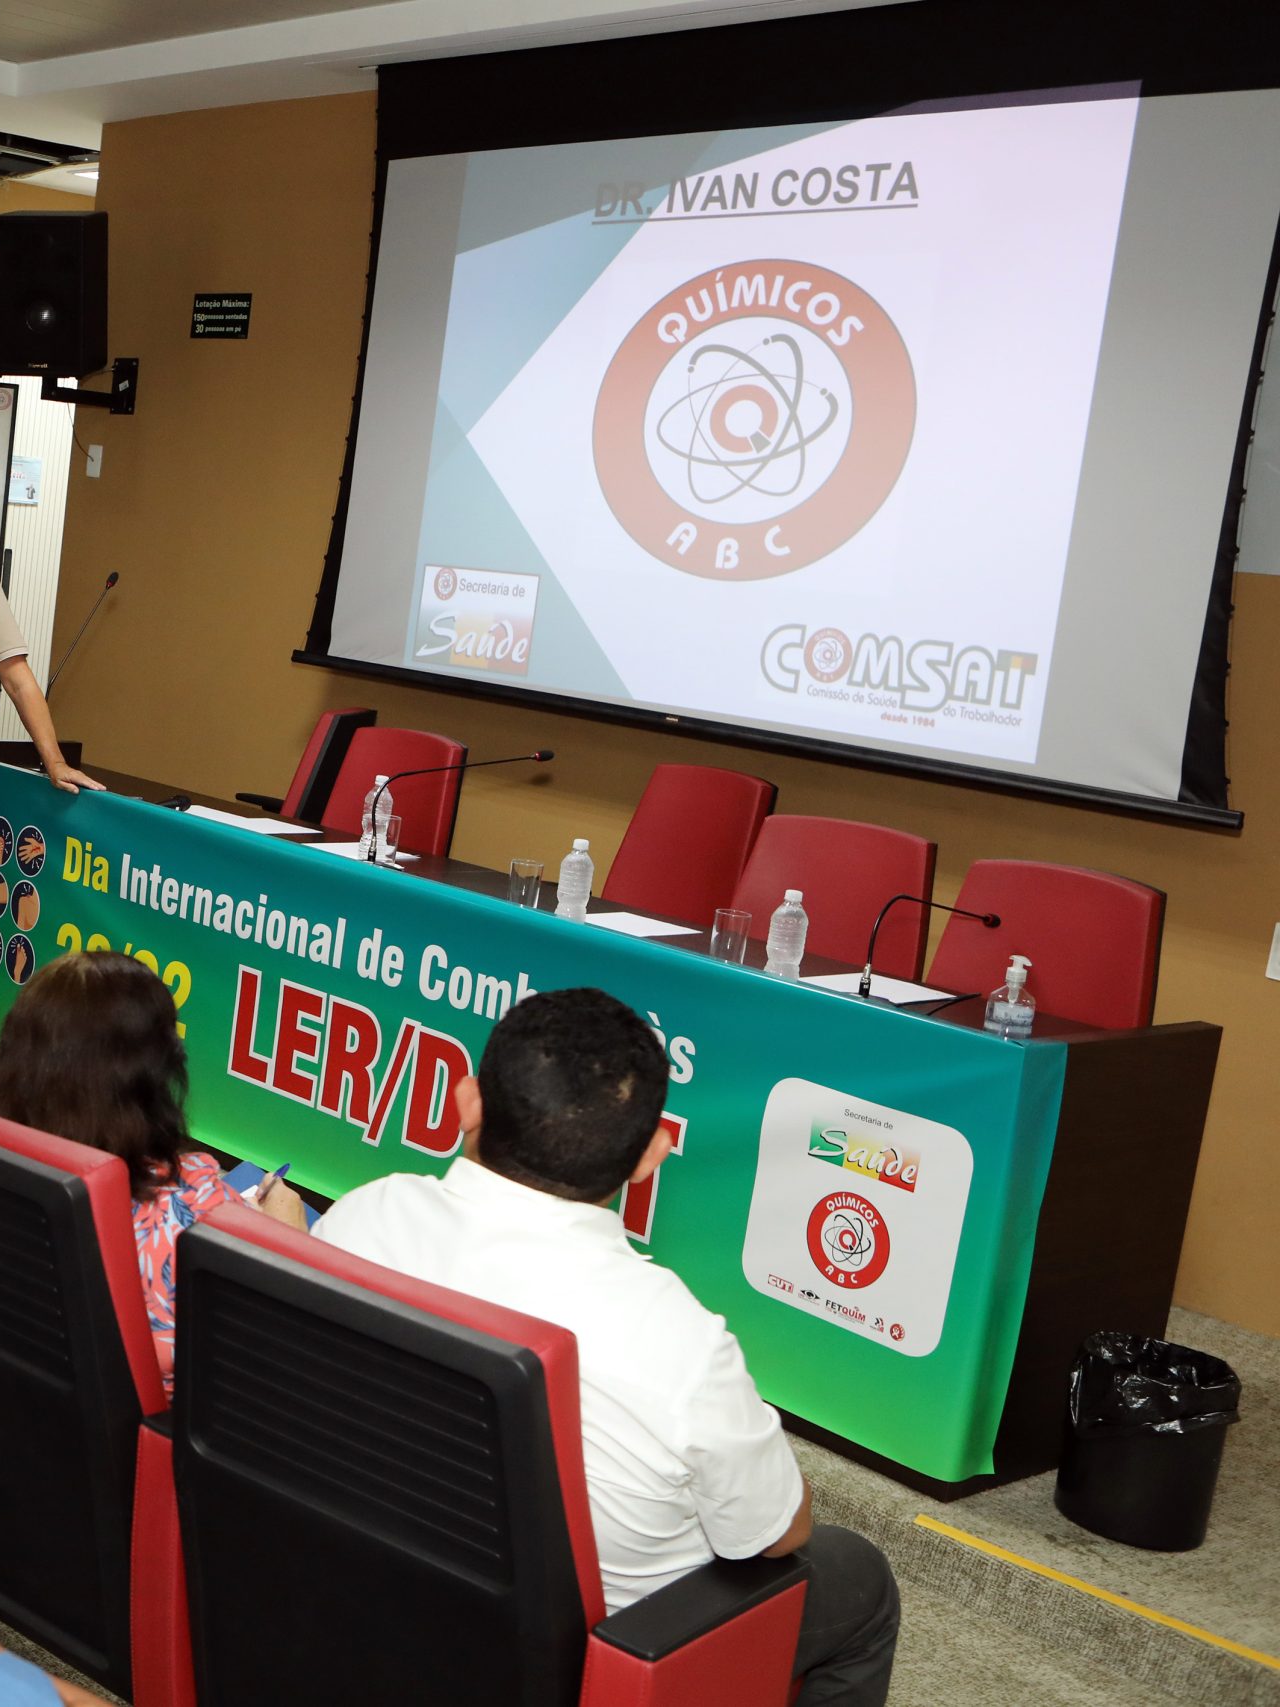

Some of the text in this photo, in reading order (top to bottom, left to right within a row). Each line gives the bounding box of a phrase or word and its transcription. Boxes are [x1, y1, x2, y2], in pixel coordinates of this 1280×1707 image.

[594, 161, 920, 218] DR. IVAN COSTA
[195, 324, 203, 333] 30
[656, 271, 865, 346] QUÍMICOS
[458, 578, 510, 597] Secretaria
[512, 584, 526, 598] de
[415, 609, 529, 664] Saúde
[759, 623, 1039, 713] COMSAT
[806, 684, 1023, 727] Comissão de Saúde do Trabalhador
[880, 711, 936, 728] desde 1984
[62, 836, 110, 894] Dia
[119, 853, 348, 970] Internacional
[356, 927, 406, 989] de
[844, 1108, 894, 1130] Secretaria de
[807, 1129, 917, 1185] Saúde
[826, 1193, 880, 1229] QUÍMICOS
